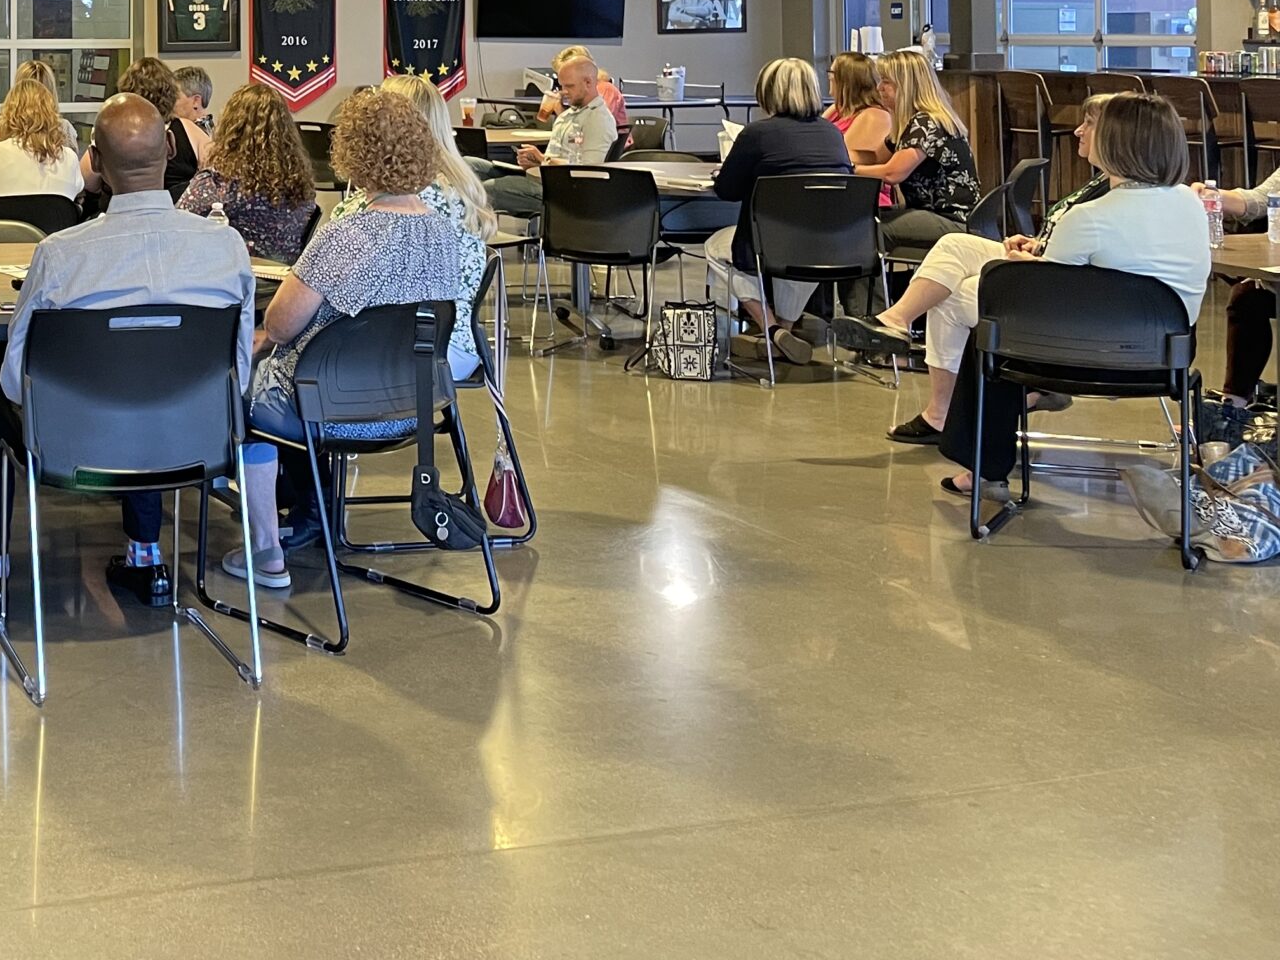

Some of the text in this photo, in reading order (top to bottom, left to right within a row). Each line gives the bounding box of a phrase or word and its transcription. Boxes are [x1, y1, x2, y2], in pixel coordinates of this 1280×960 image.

[193, 12, 206, 31] 3
[281, 36, 308, 46] 2016
[413, 39, 438, 49] 2017
